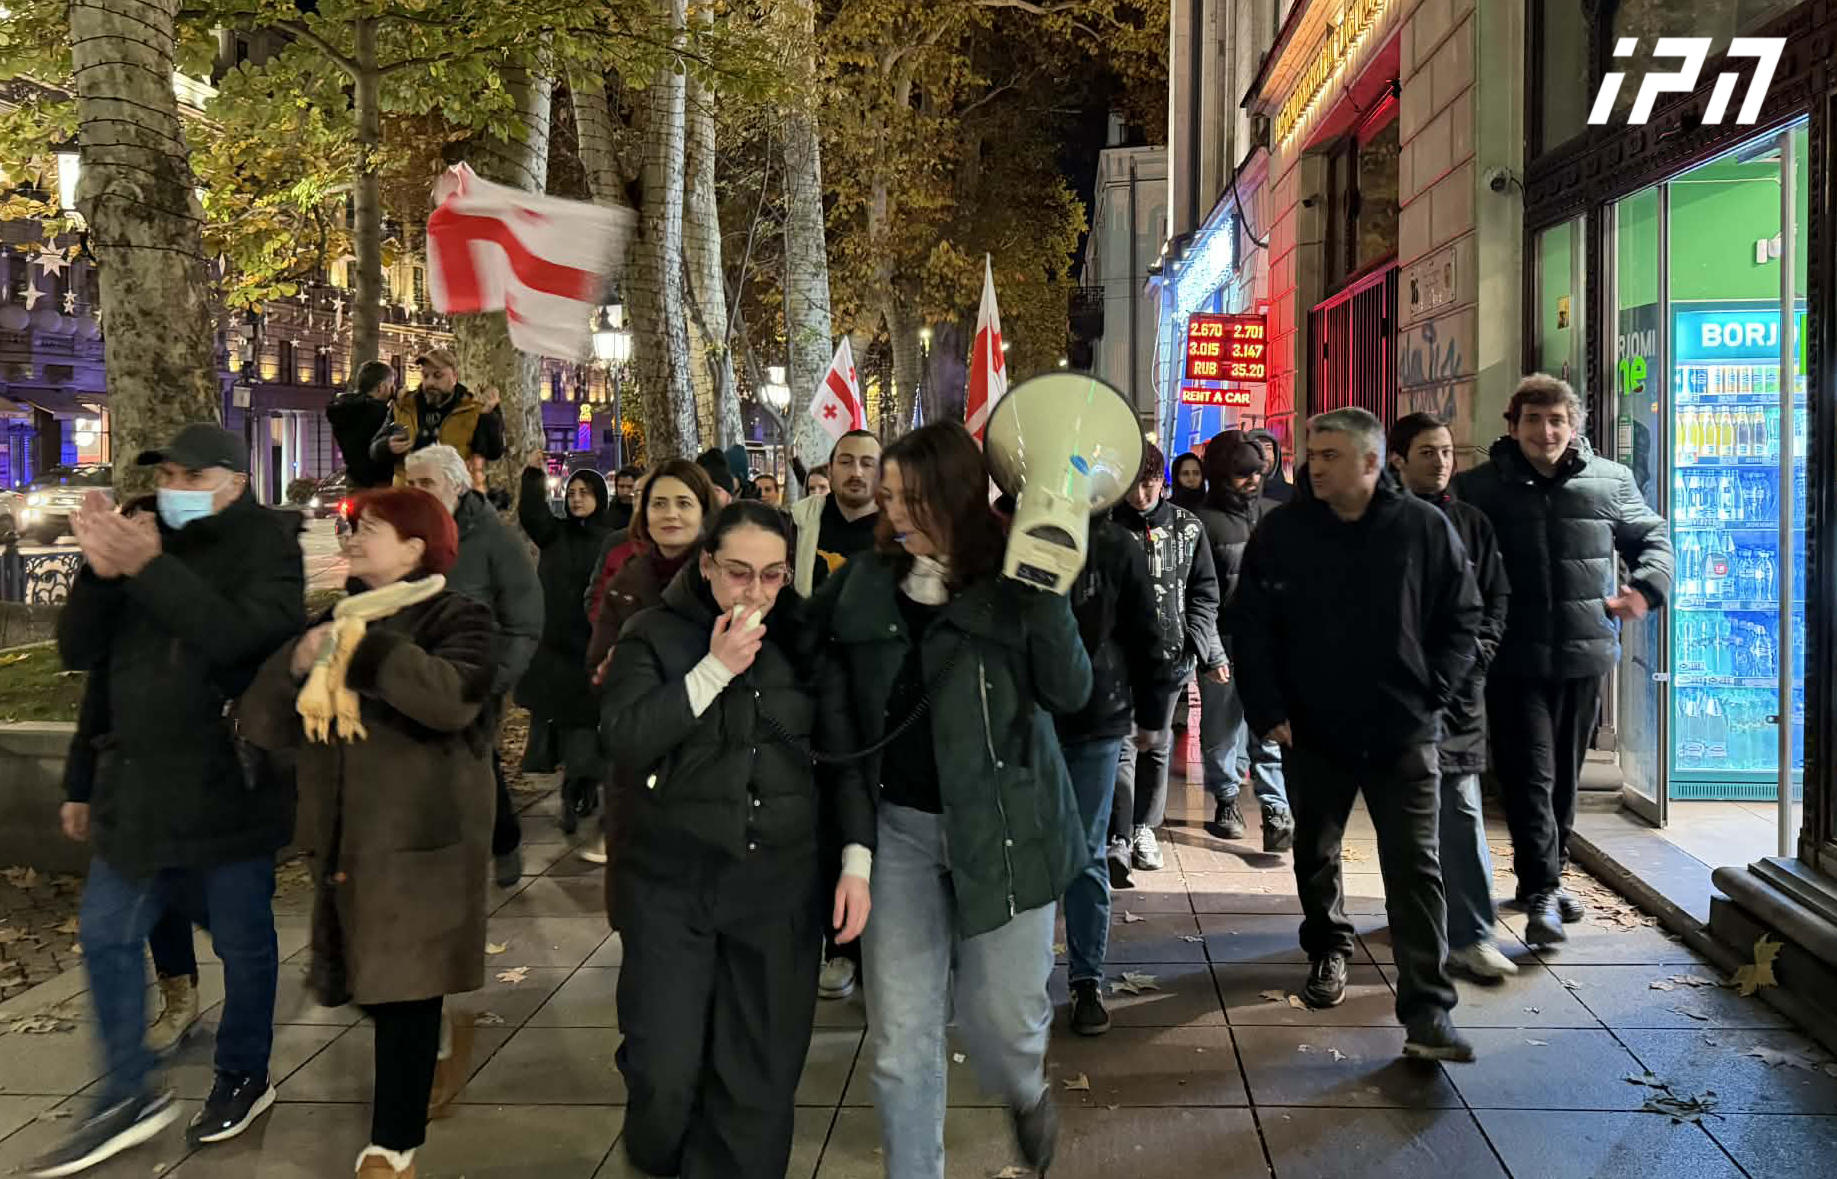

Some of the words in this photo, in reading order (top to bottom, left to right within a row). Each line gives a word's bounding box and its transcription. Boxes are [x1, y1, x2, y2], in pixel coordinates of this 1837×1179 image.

[1190, 323, 1222, 337] 2.670
[1233, 325, 1264, 339] 2.701
[1232, 344, 1264, 359] 3.147
[1193, 362, 1217, 375] RUB
[1231, 363, 1264, 378] 35.20
[1182, 391, 1212, 402] RENT
[1213, 391, 1223, 403] A
[1225, 392, 1251, 404] CAR
